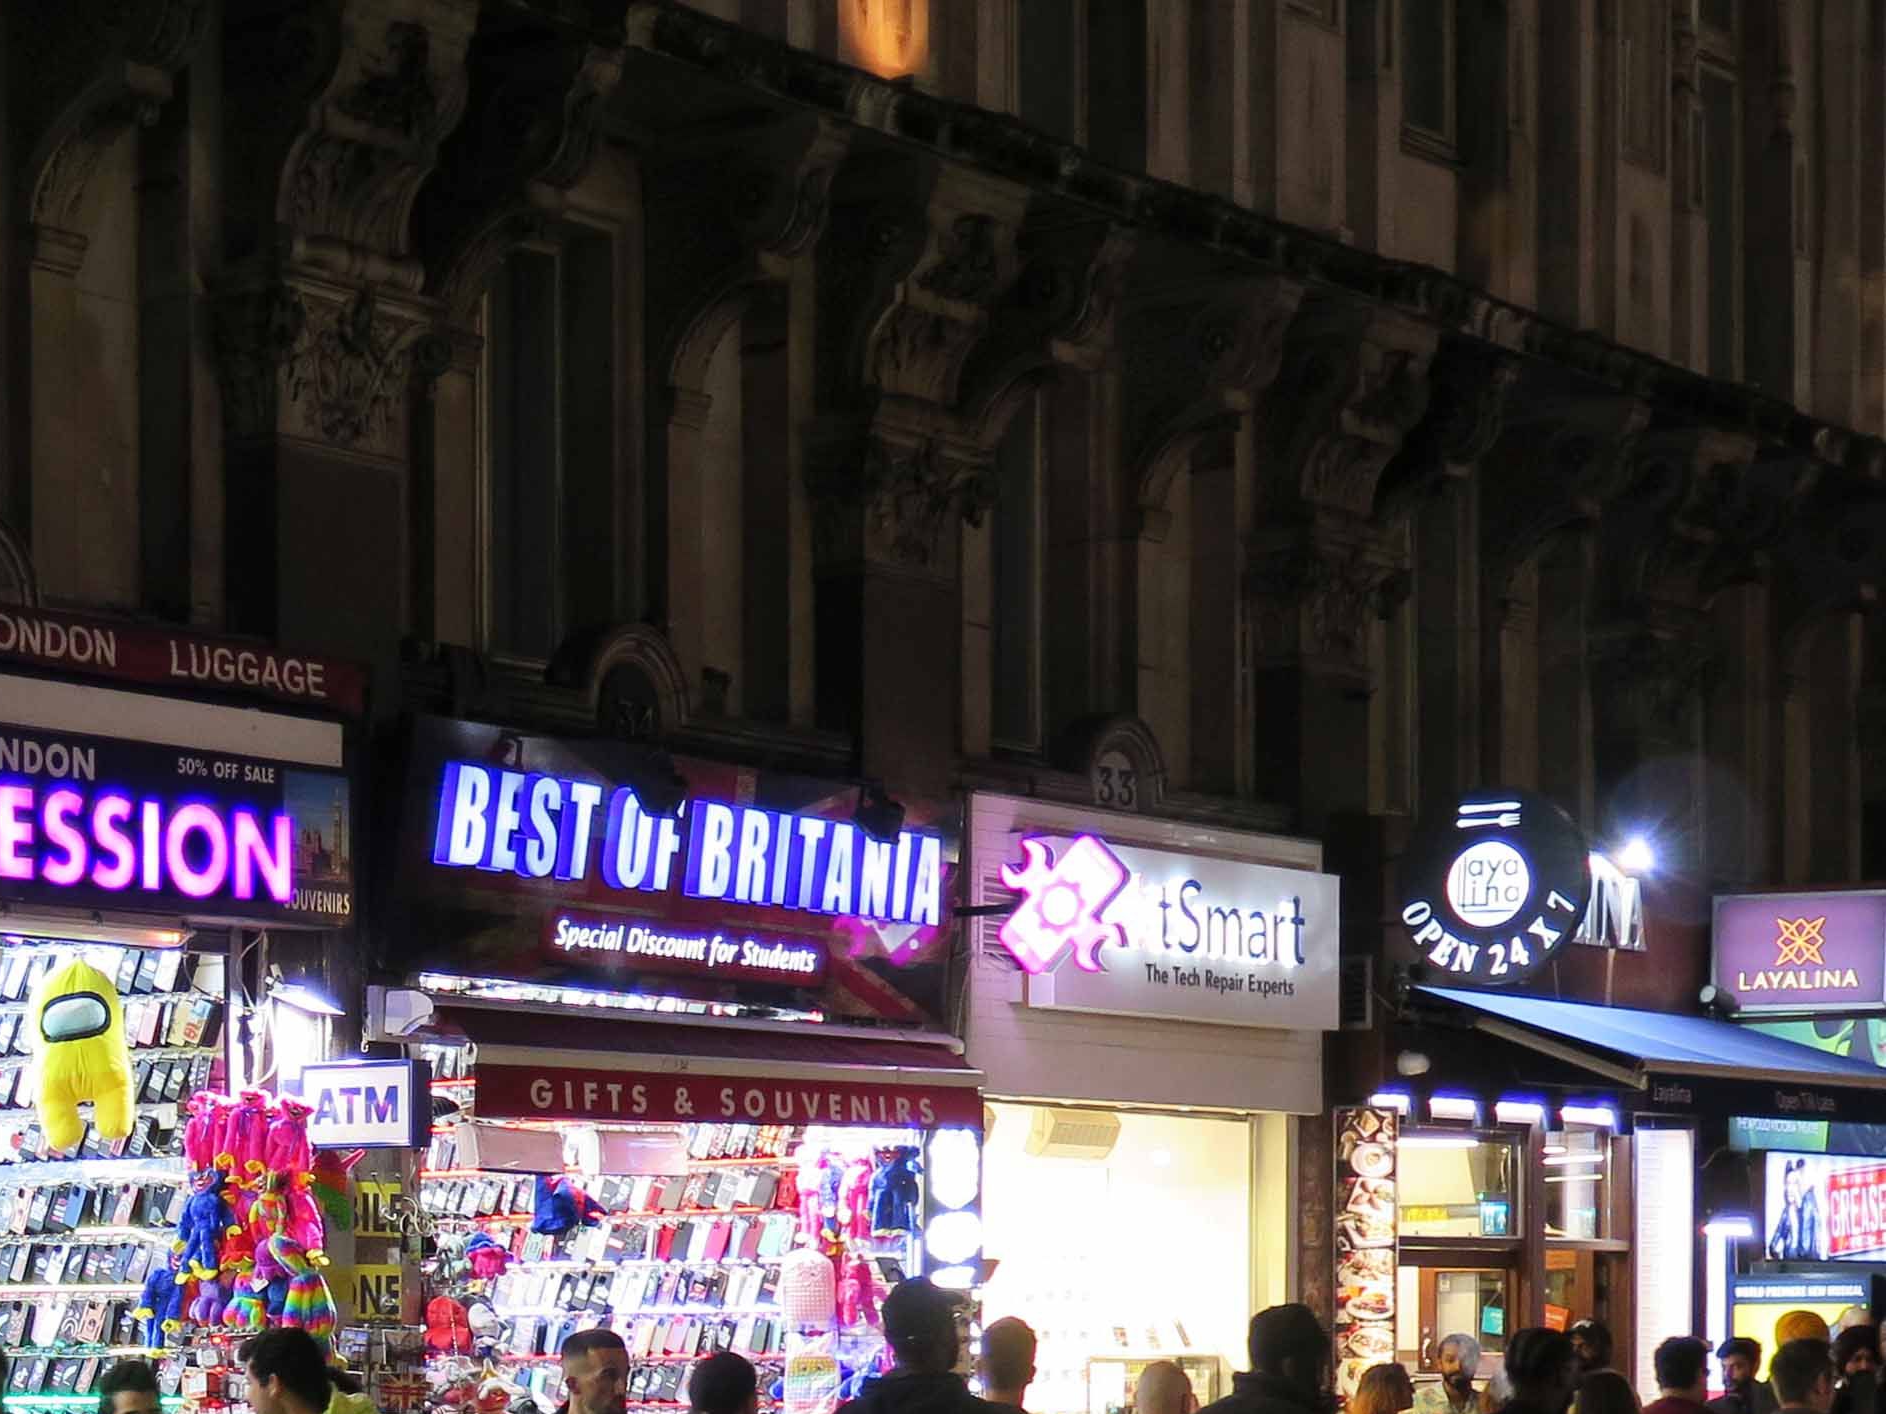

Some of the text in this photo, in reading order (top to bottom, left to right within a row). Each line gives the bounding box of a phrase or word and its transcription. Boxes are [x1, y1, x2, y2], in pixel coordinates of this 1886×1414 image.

[169, 640, 325, 698] LUGGAGE
[177, 756, 275, 785] 50% OFF SALE
[1097, 766, 1135, 806] 33
[434, 761, 942, 927] BEST OF BRITANIA
[554, 919, 818, 974] Special Discount for Students
[1402, 900, 1480, 973] OPEN
[1488, 936, 1529, 975] 24
[1547, 890, 1576, 913] 7
[1145, 963, 1295, 998] The Tech Repair Experts
[1738, 969, 1858, 991] LAYALINA
[313, 1085, 399, 1125] ATM
[529, 1078, 936, 1124] GIFTS & SOUVENIRS
[1653, 1083, 1692, 1103] Layalina
[1830, 1184, 1886, 1238] GREASE
